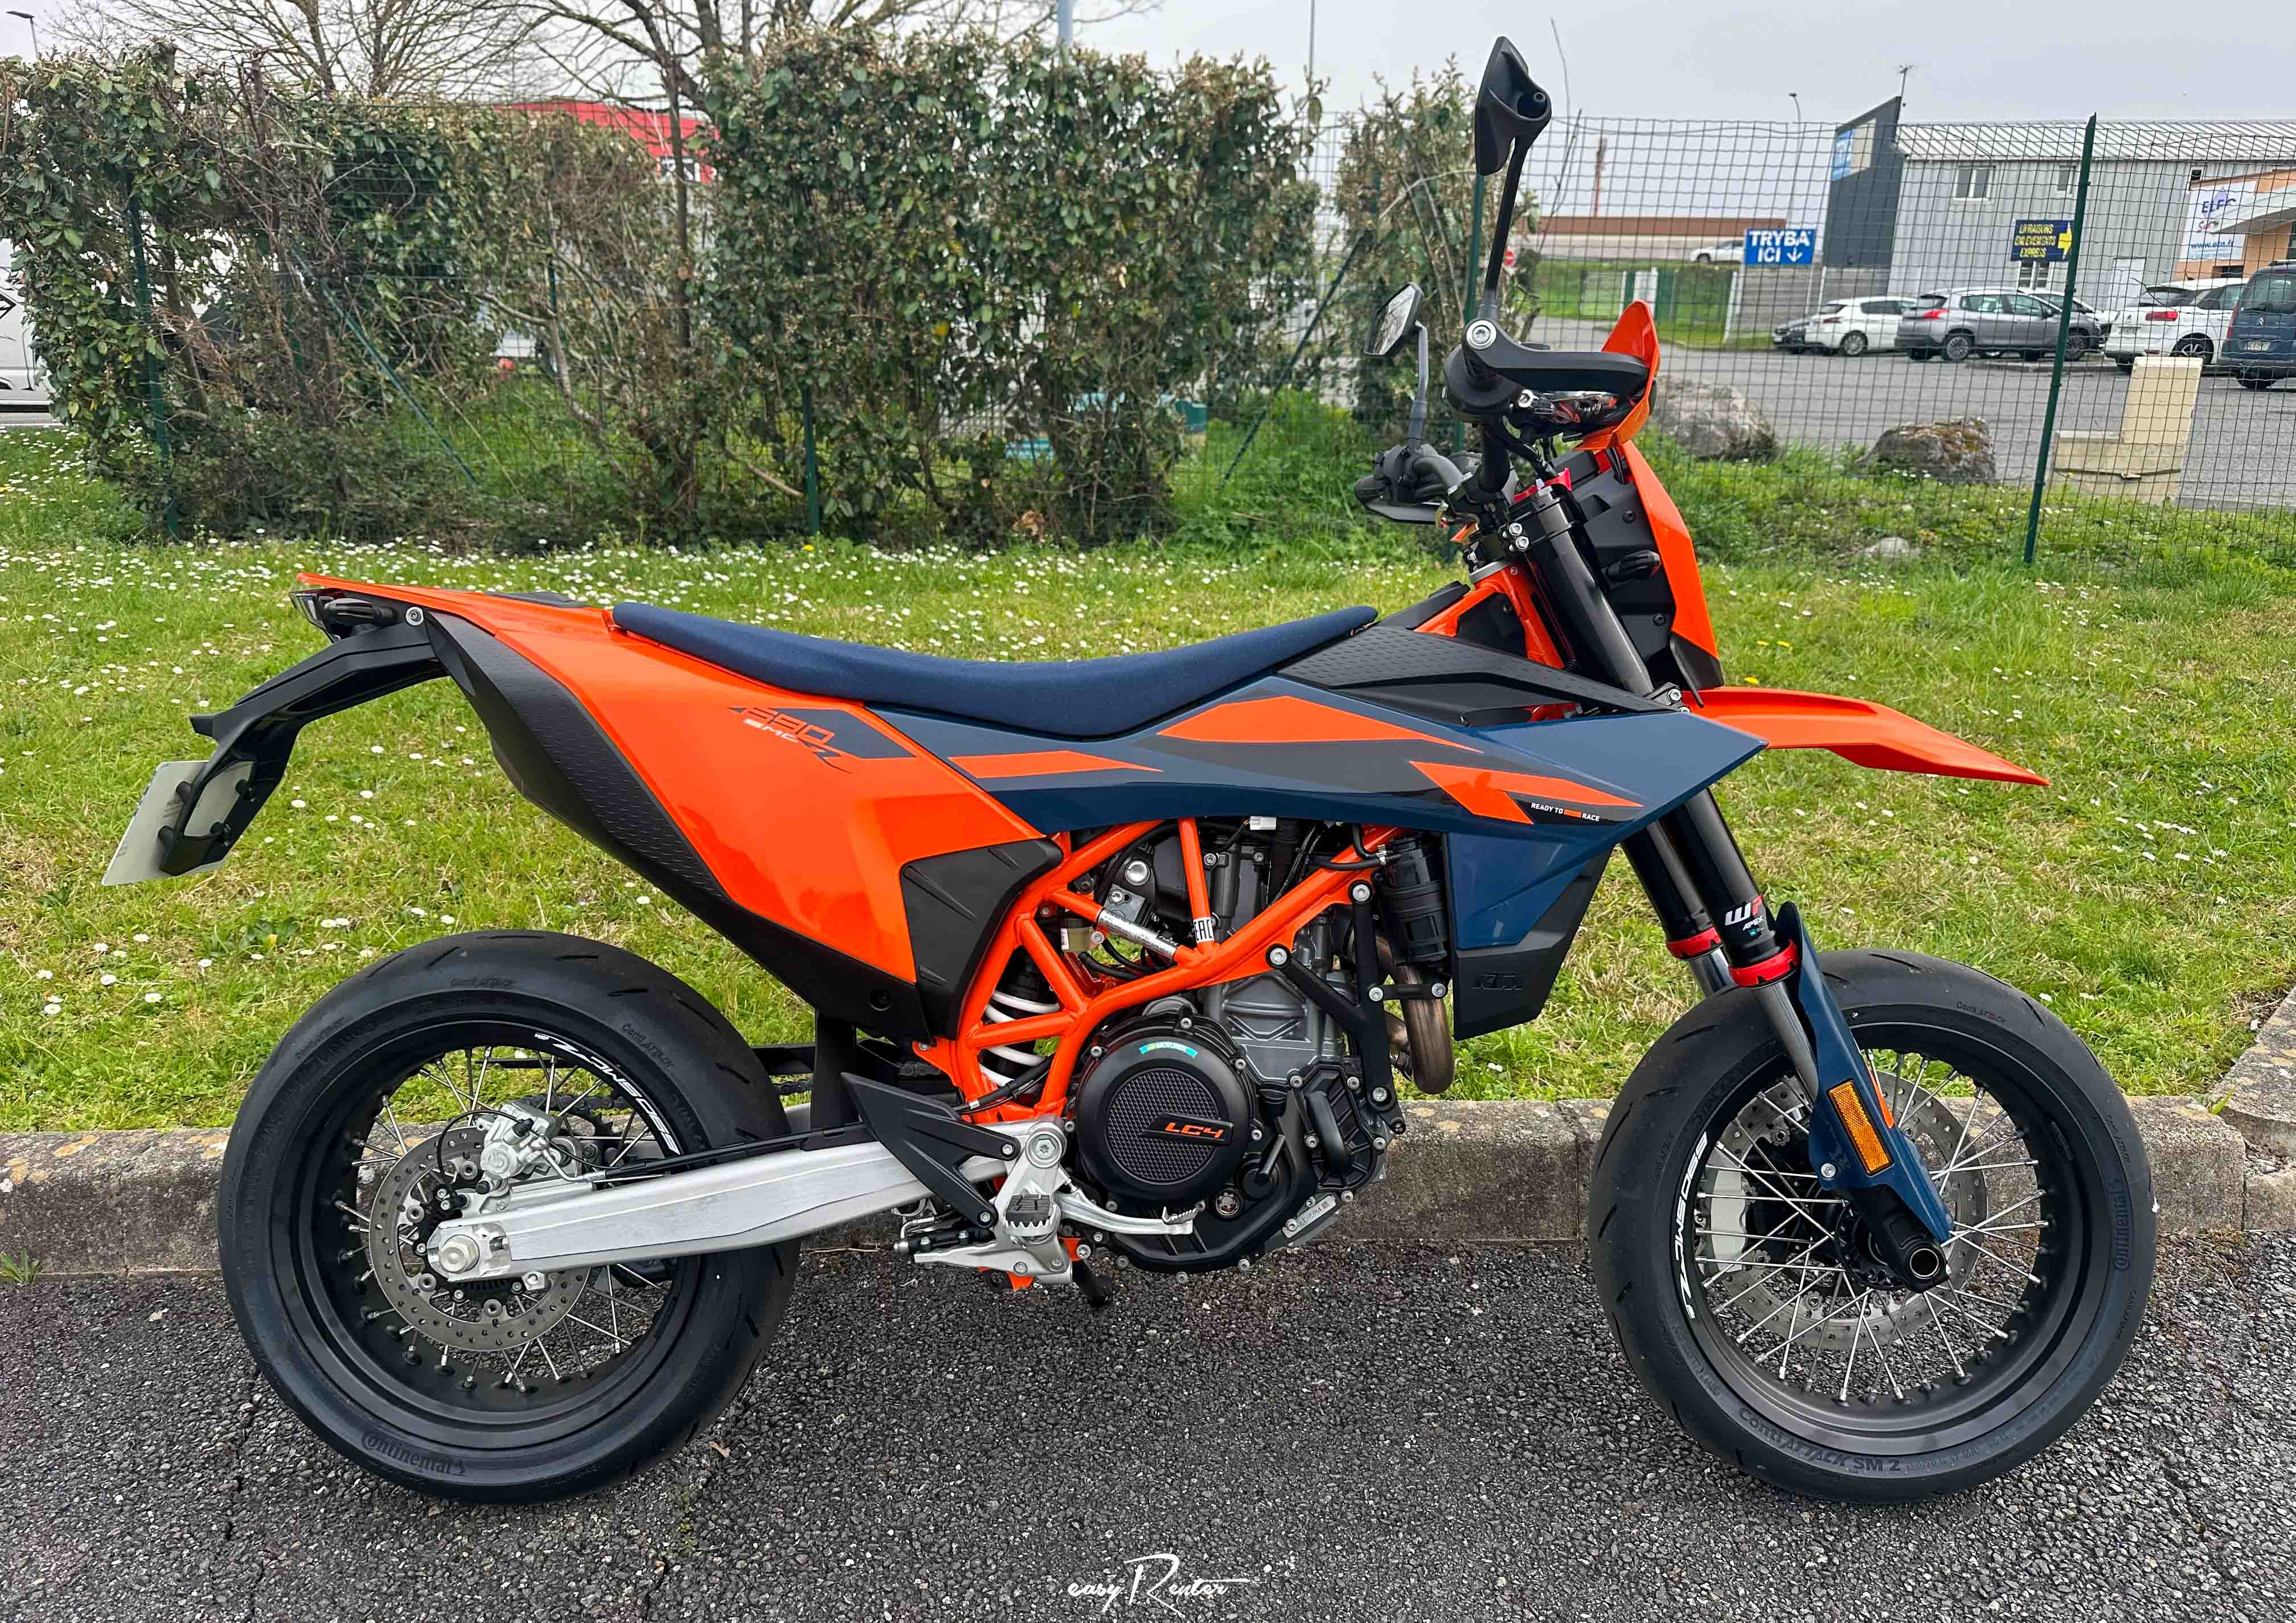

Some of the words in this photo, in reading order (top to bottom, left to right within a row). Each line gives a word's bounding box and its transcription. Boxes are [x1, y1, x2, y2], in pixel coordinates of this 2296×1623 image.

[1749, 230, 1810, 246] TRYBA
[1757, 246, 1782, 262] ICI
[1531, 802, 1554, 813] READY
[1581, 812, 1601, 821] RACE
[1742, 915, 1764, 931] APEX
[1166, 1122, 1224, 1139] LC4
[360, 1431, 454, 1476] Continental
[1853, 1456, 1884, 1472] SM
[1888, 1458, 1901, 1472] 2
